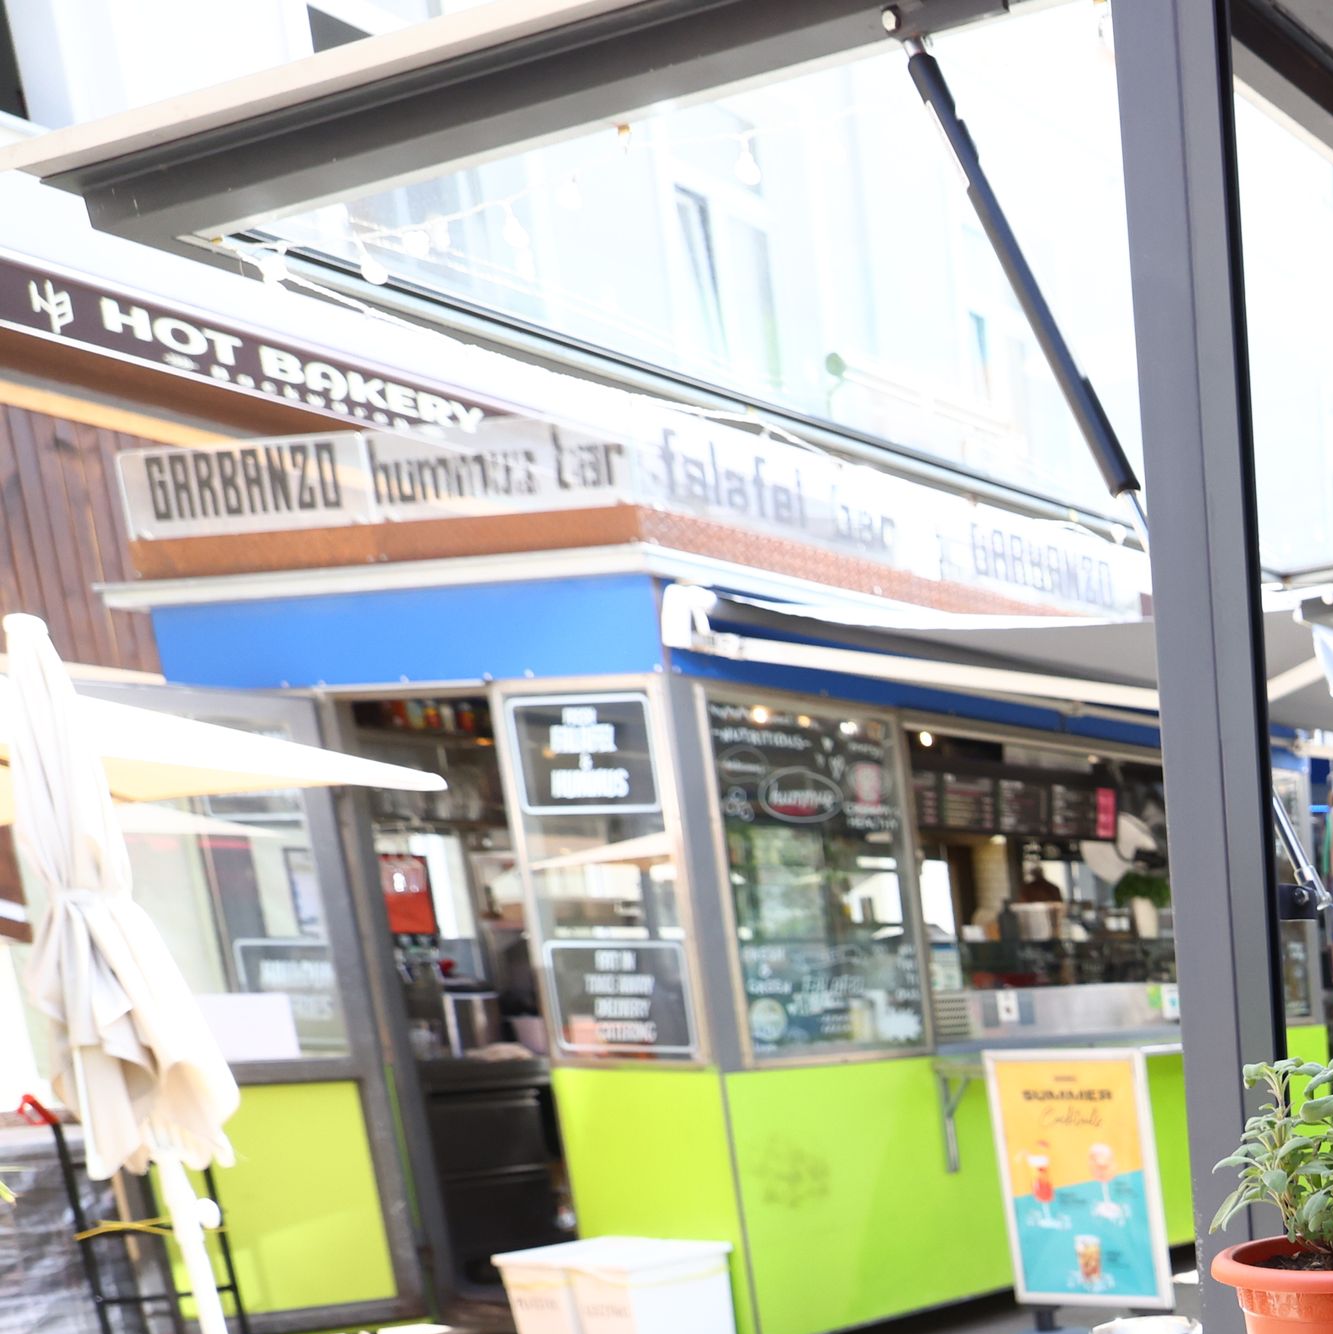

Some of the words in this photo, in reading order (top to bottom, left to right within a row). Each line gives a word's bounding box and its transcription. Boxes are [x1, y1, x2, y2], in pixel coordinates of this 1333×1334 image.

[100, 296, 243, 366] HOT
[259, 344, 484, 434] BAKERY
[146, 441, 342, 520] GARBANZO
[368, 438, 535, 504] hummus
[661, 427, 806, 529] falafel
[970, 522, 1114, 609] GARBANZO
[1022, 1089, 1112, 1101] SUMMER
